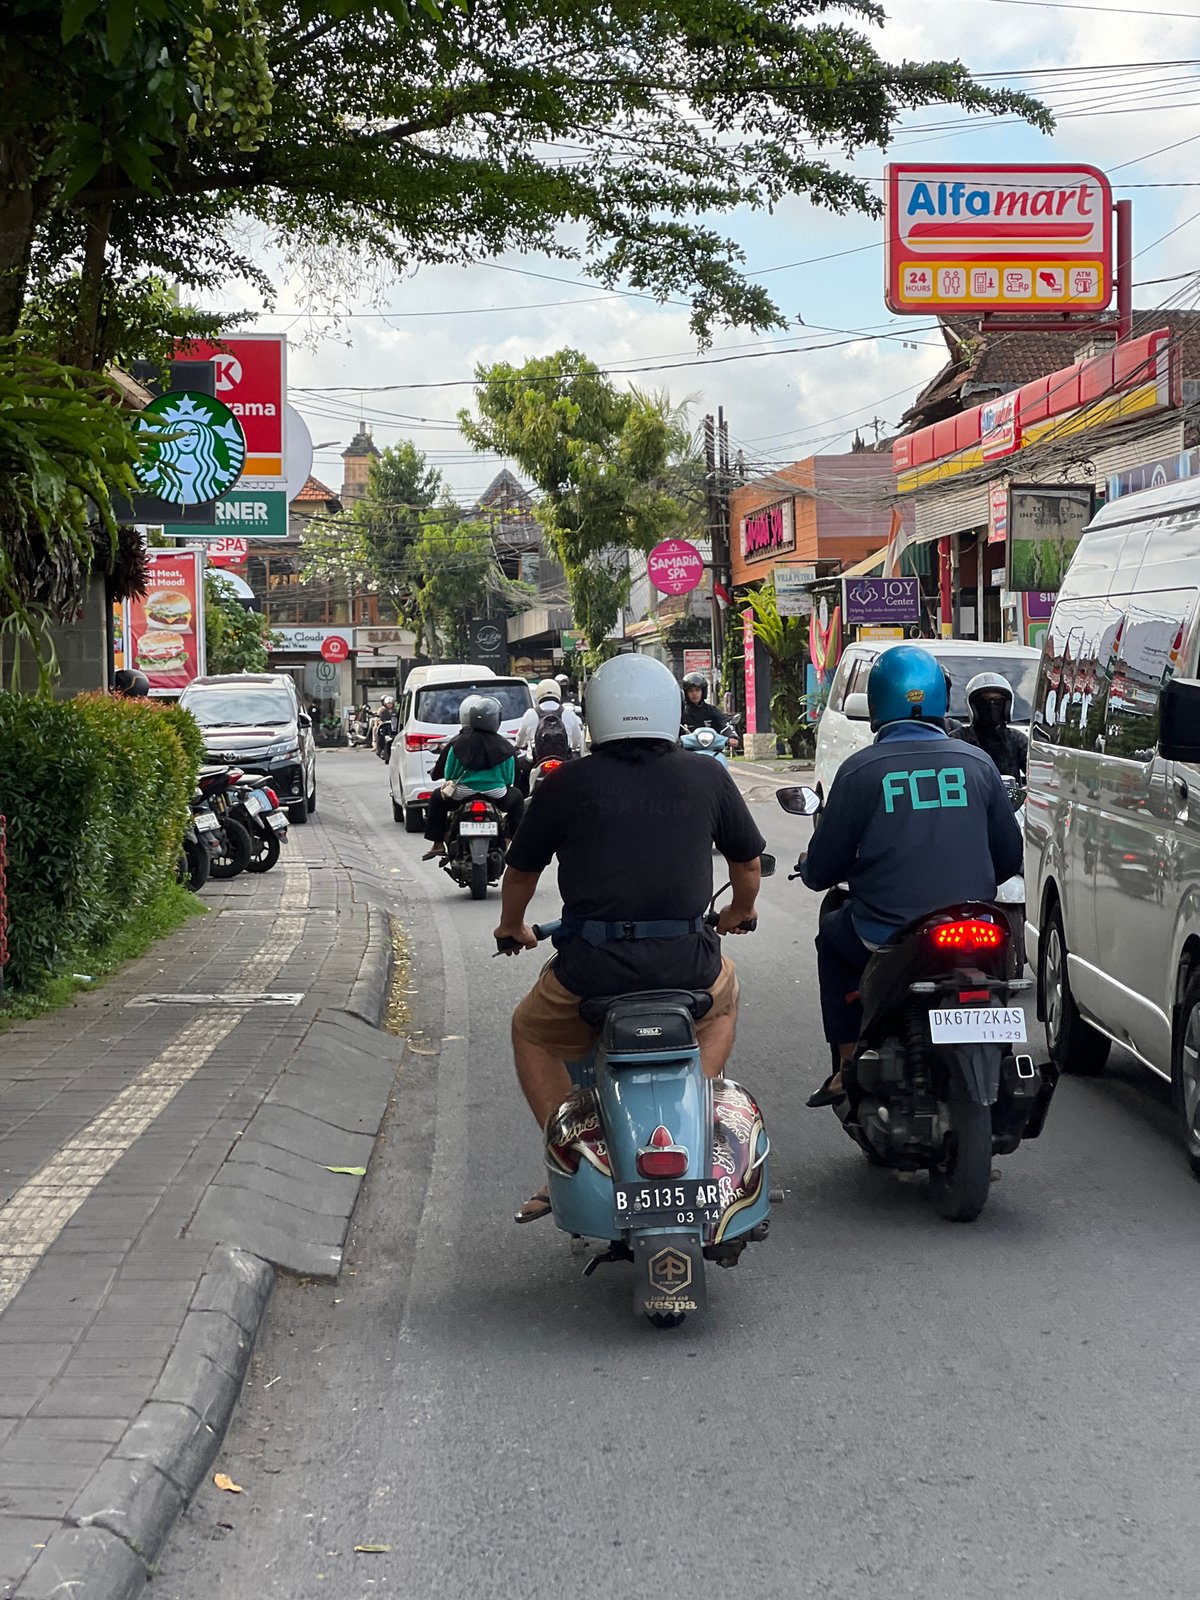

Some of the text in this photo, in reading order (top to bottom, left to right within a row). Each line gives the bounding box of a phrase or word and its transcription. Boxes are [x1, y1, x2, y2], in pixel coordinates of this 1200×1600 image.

[907, 182, 1095, 216] Alfamart
[909, 272, 927, 284] 24
[905, 284, 931, 292] HOURS
[225, 402, 276, 416] rama
[215, 501, 269, 520] RNER
[216, 538, 244, 551] SPA
[157, 569, 183, 578] Meat,
[667, 567, 688, 580] SPA
[157, 578, 185, 586] Mood!
[881, 582, 915, 600] JOY
[886, 596, 914, 606] Center
[294, 631, 324, 641] Clouds
[367, 630, 402, 643] SUKA
[882, 767, 969, 814] FCB
[616, 1184, 718, 1211] B 5135 AR
[677, 1209, 720, 1223] 03 14
[643, 1300, 698, 1313] vespa
